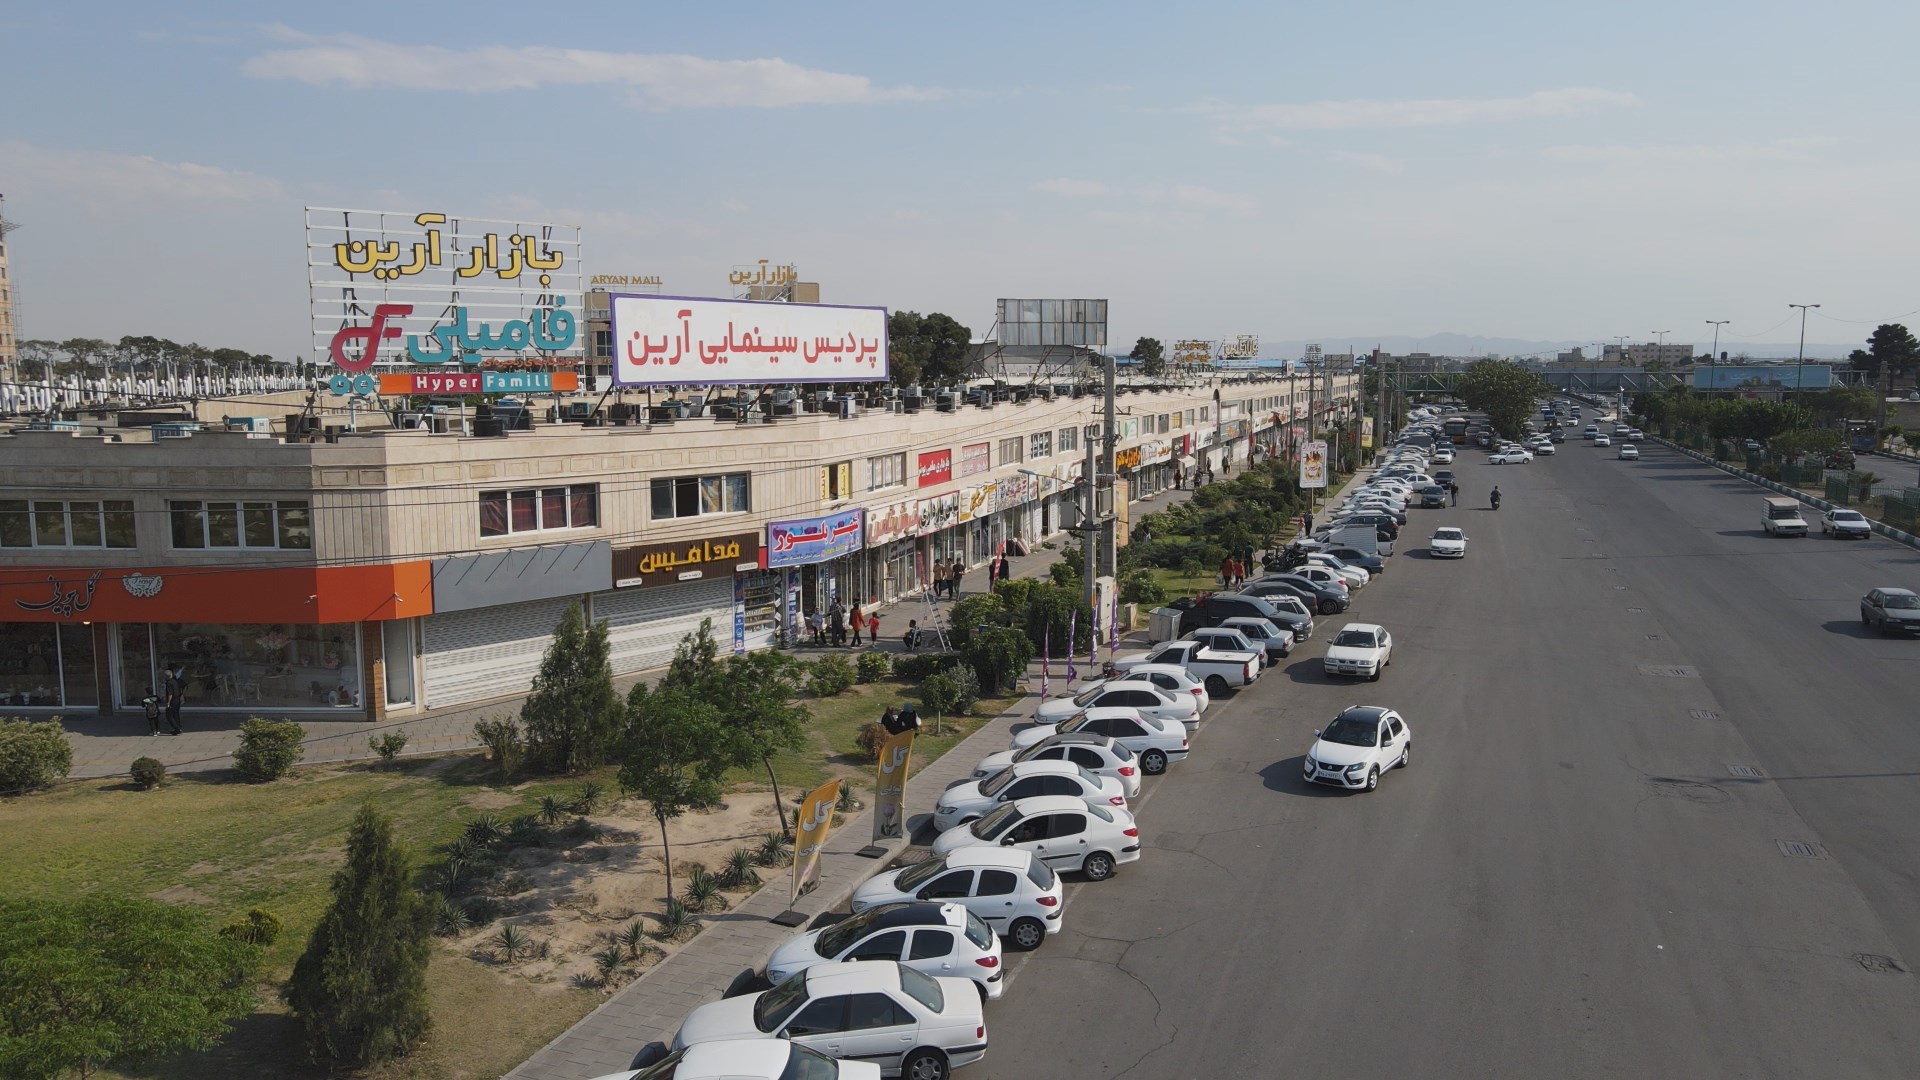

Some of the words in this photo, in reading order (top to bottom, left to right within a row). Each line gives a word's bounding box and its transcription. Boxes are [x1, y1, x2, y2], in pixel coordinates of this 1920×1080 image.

[335, 212, 446, 280] آرین
[458, 233, 563, 285] بازار
[591, 275, 628, 285] ARYAN
[632, 276, 663, 285] MALL
[729, 259, 768, 286] آرین
[766, 264, 797, 285] بازار
[407, 295, 576, 364] فامیلی
[627, 309, 692, 366] آرین
[699, 322, 798, 365] سینمایی
[803, 331, 879, 369] پردیس
[416, 376, 478, 391] Hyper
[487, 374, 549, 388] Famili
[773, 519, 828, 552] بلور
[883, 746, 909, 774] گل
[802, 800, 834, 832] گل
